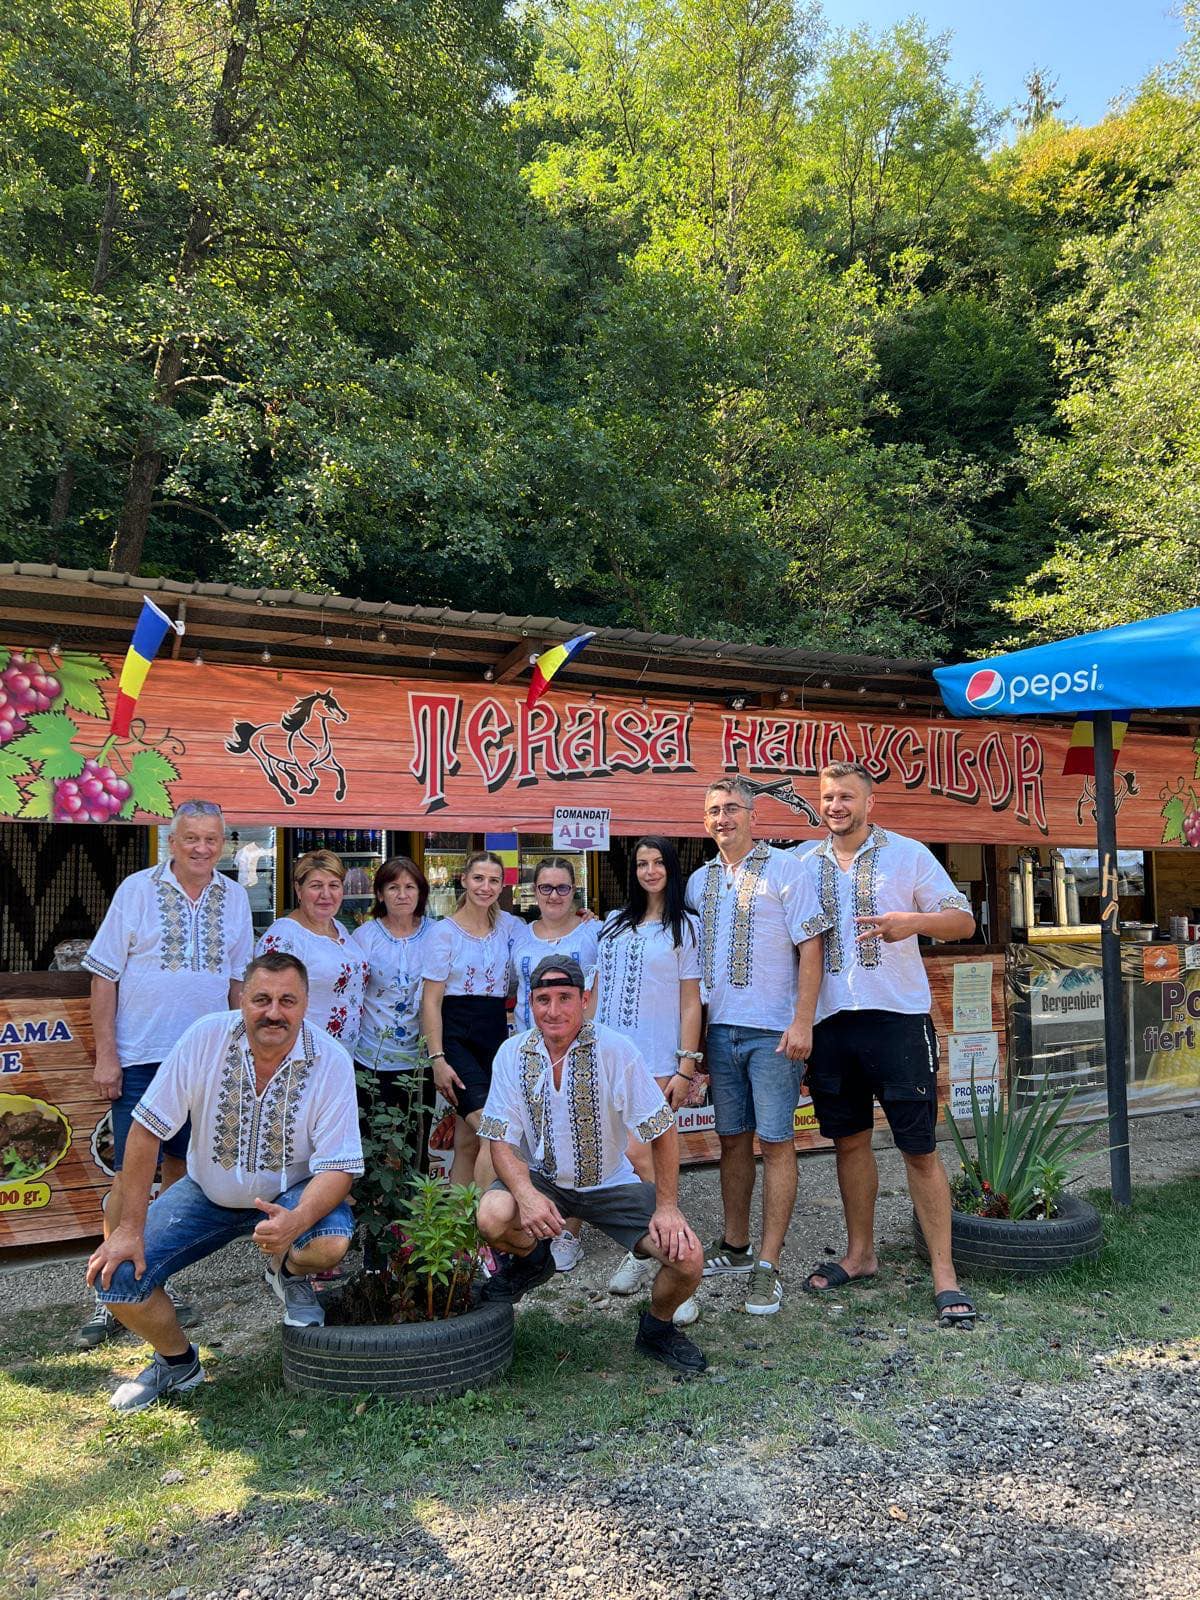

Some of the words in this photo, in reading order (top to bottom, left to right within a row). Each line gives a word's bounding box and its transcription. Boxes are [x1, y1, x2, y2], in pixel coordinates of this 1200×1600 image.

[1009, 664, 1100, 704] pepsi
[1041, 990, 1102, 1014] Bergenbier
[1143, 1026, 1196, 1052] fiert
